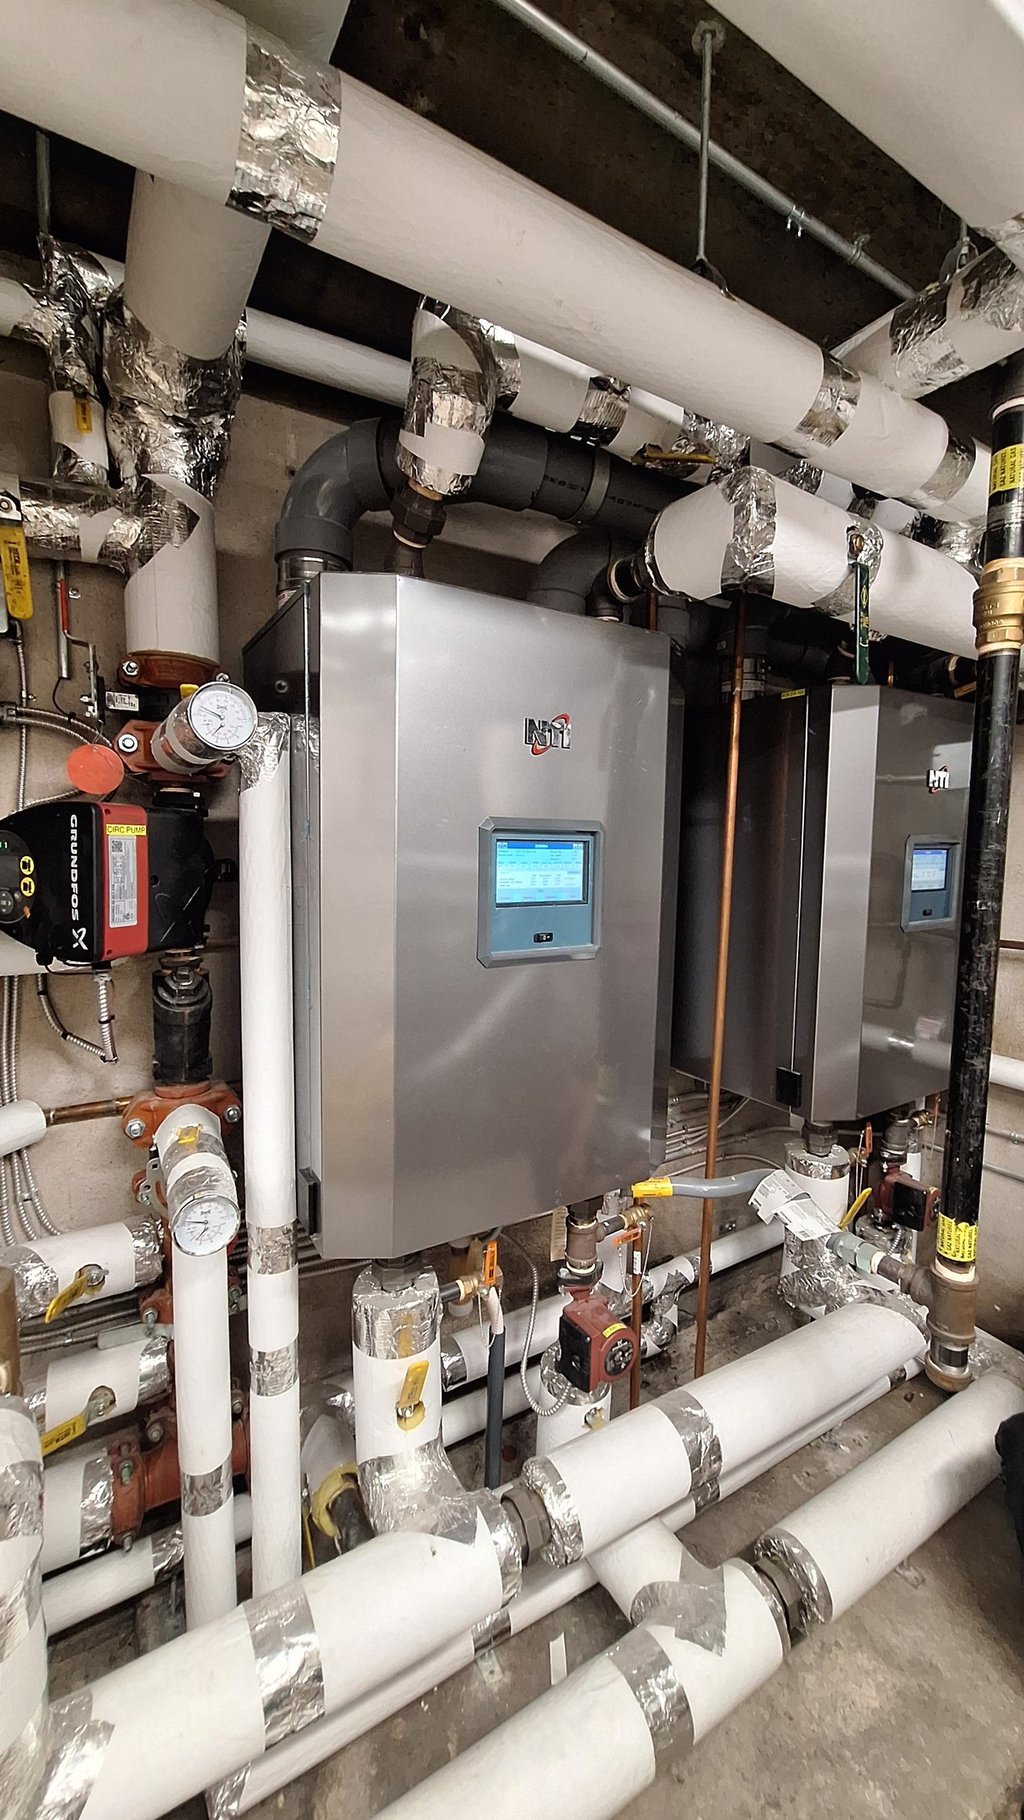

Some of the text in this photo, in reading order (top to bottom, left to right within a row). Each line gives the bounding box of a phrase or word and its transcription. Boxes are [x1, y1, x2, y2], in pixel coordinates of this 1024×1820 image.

[107, 825, 146, 834] CIRC PUMP
[70, 814, 79, 921] GRUNDFOS
